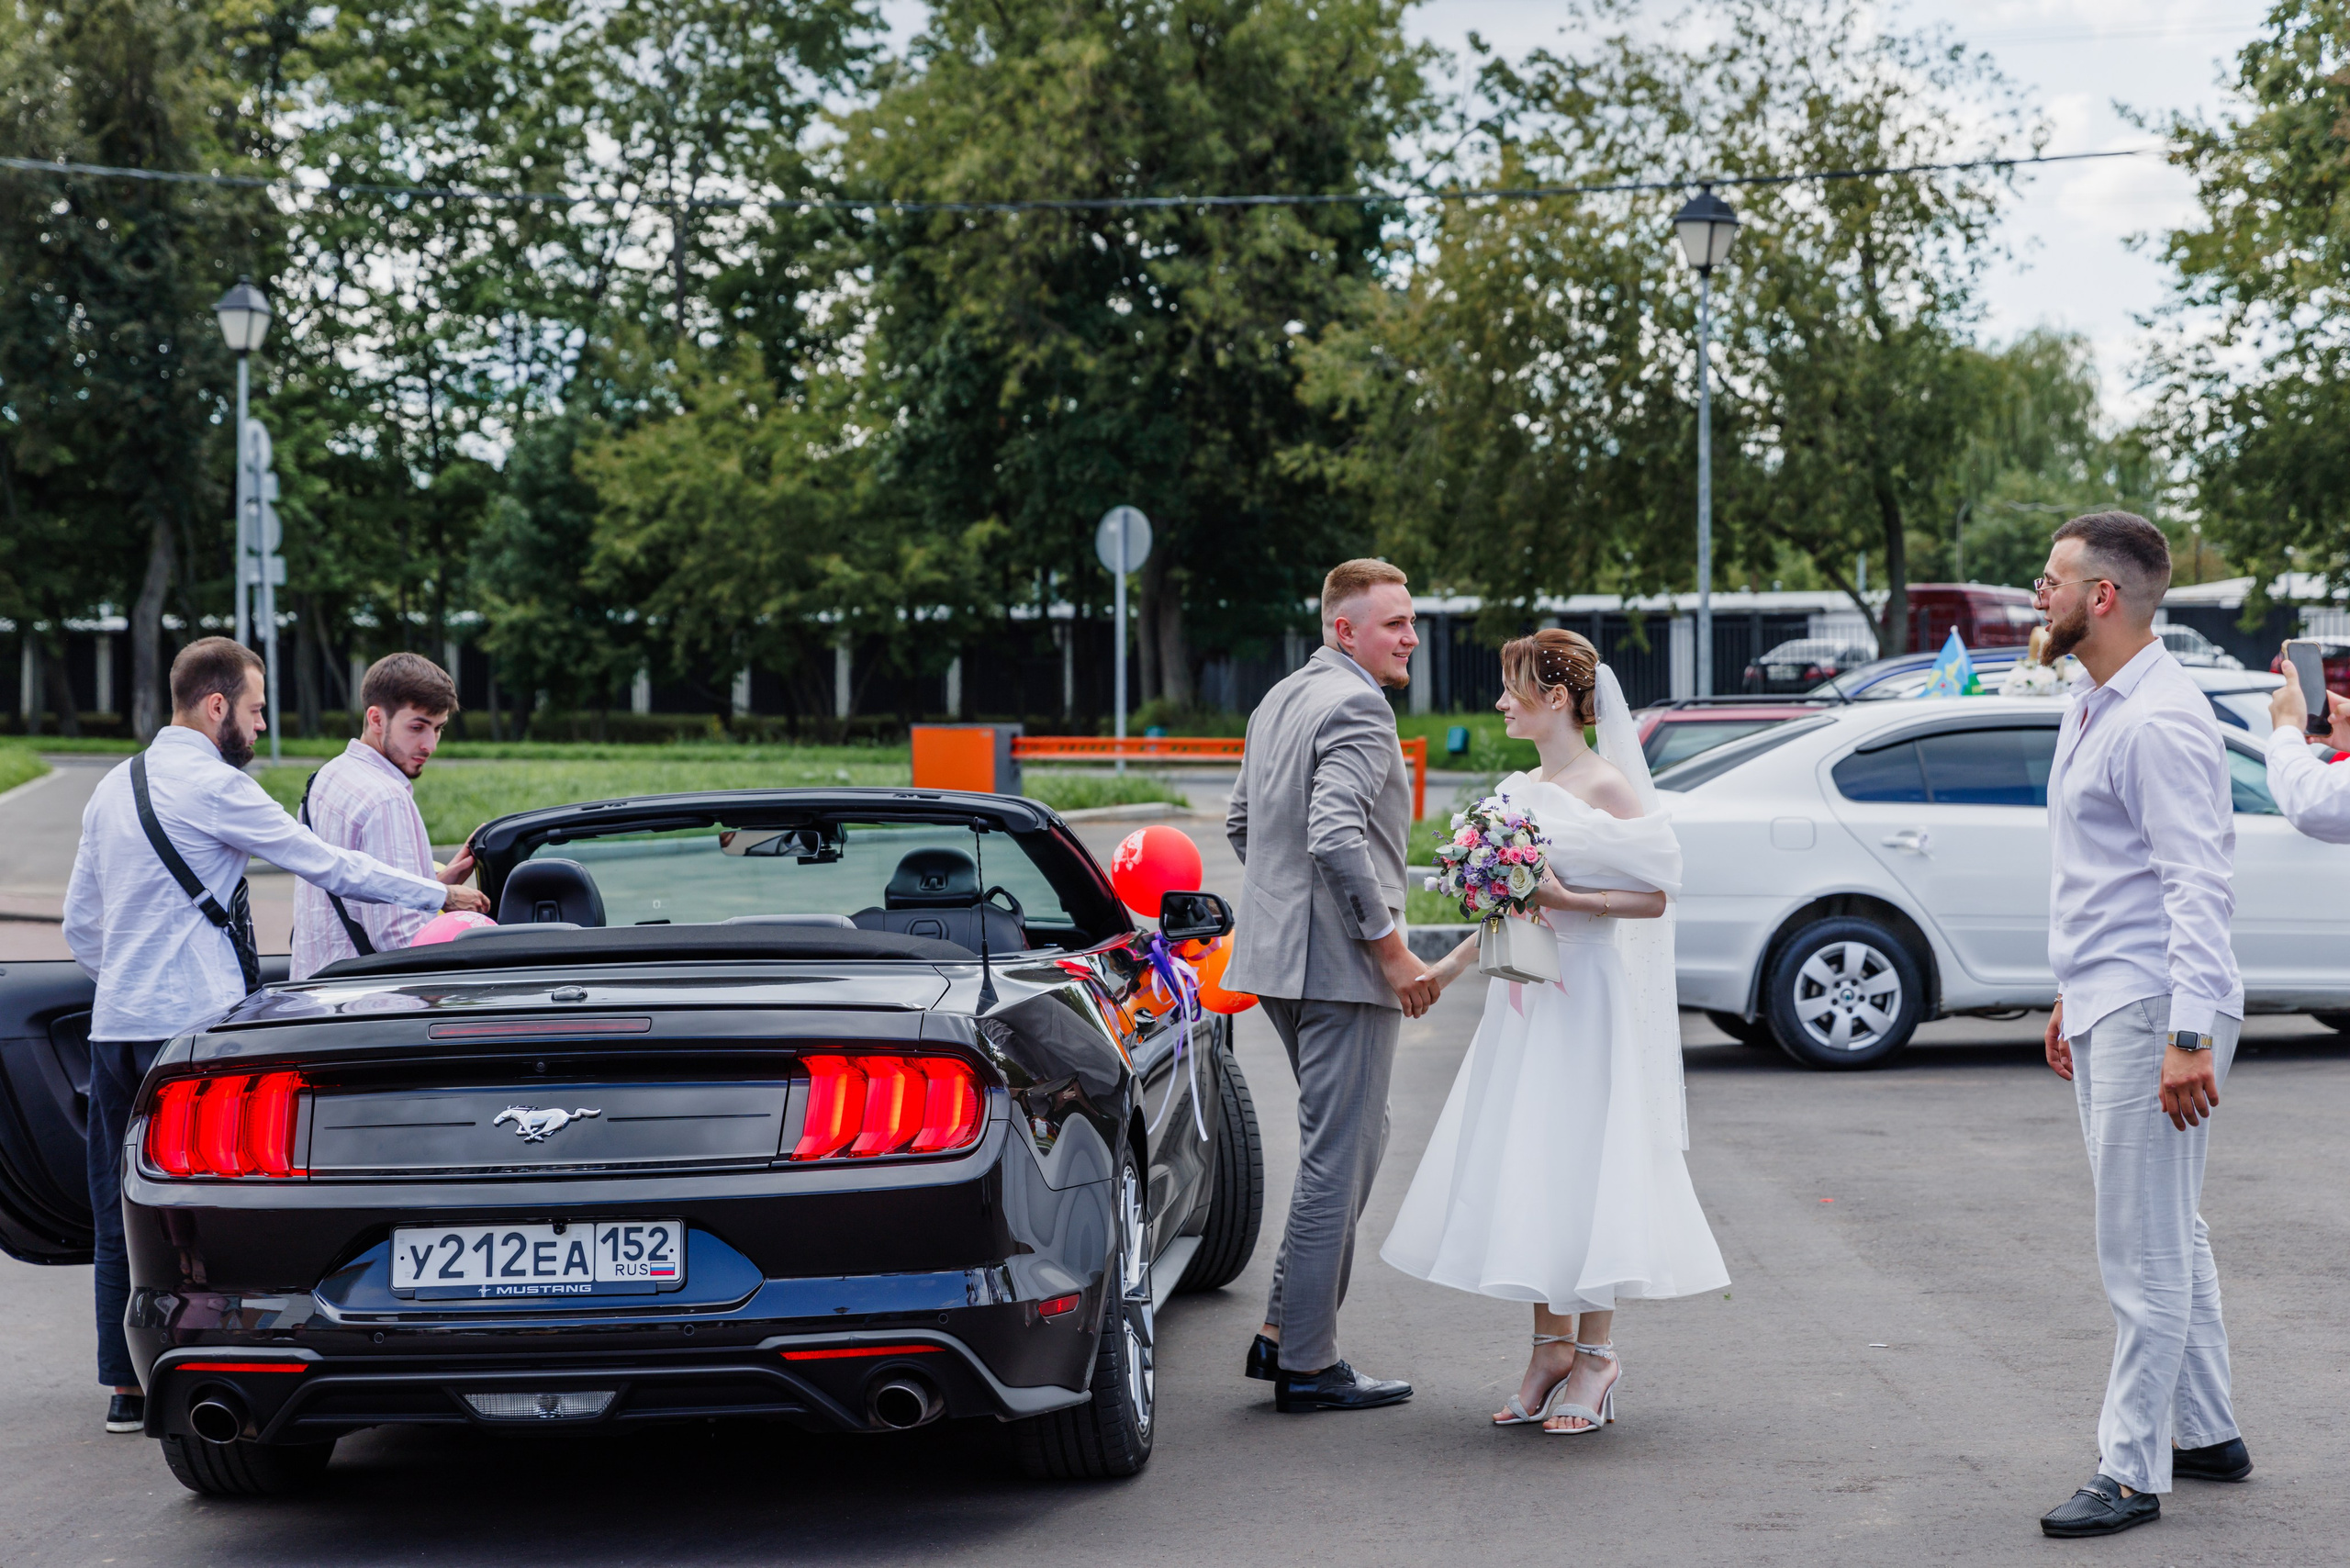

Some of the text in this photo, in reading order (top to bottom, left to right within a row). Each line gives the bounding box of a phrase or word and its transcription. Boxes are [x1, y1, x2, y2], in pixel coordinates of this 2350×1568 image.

[600, 1226, 669, 1262] 152
[615, 1263, 648, 1276] RUS
[496, 1284, 592, 1294] MUSTANG
